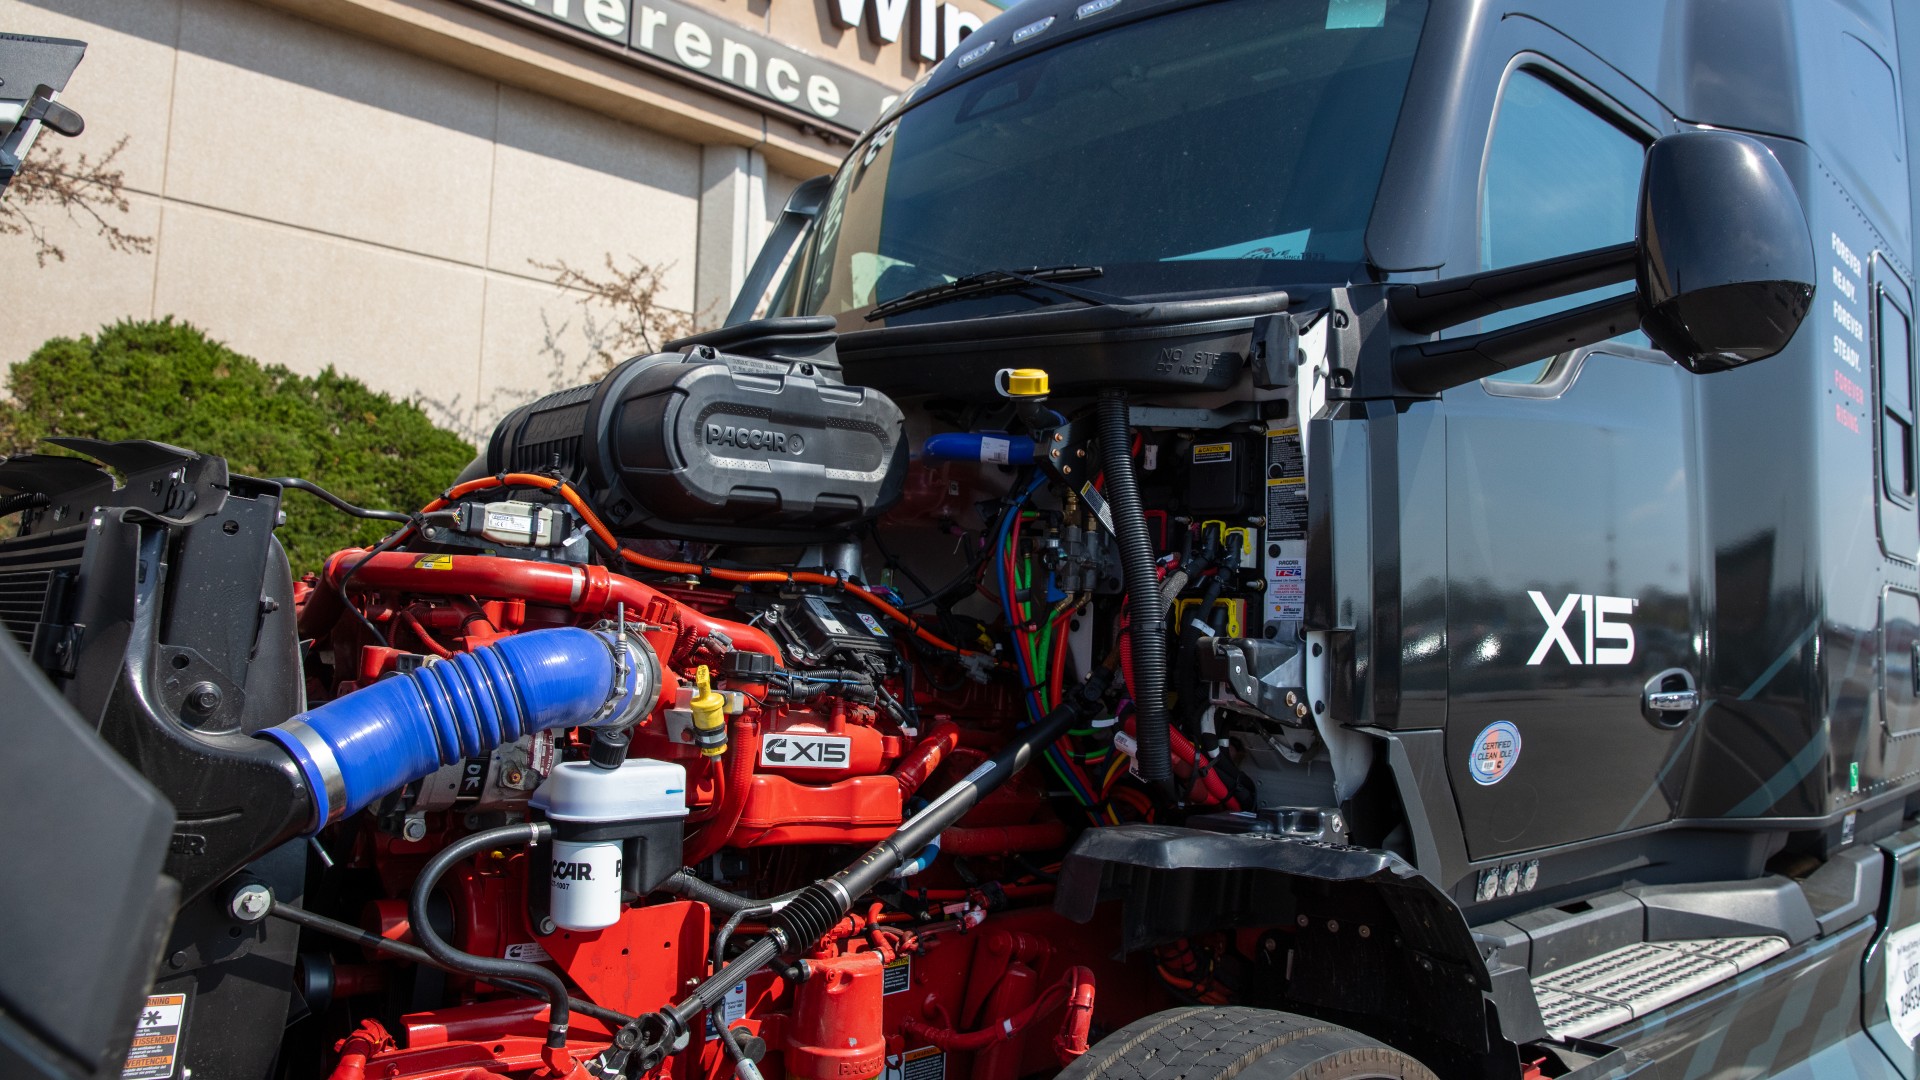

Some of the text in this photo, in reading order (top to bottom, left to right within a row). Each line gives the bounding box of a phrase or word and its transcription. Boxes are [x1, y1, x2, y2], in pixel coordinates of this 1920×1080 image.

[1832, 232, 1862, 279] FOREVER
[1832, 266, 1858, 304] READY.
[1833, 300, 1864, 342] FOREVER
[1161, 347, 1184, 361] NO
[1179, 364, 1202, 375] NOT
[1833, 335, 1862, 372] STEADY.
[1834, 369, 1864, 405] FOREVER
[706, 423, 786, 453] PACCAR
[1526, 590, 1636, 665] X15
[790, 742, 846, 763] X15
[1477, 750, 1512, 760] CLEAN IDLE
[1482, 740, 1512, 750] CERTIFIED
